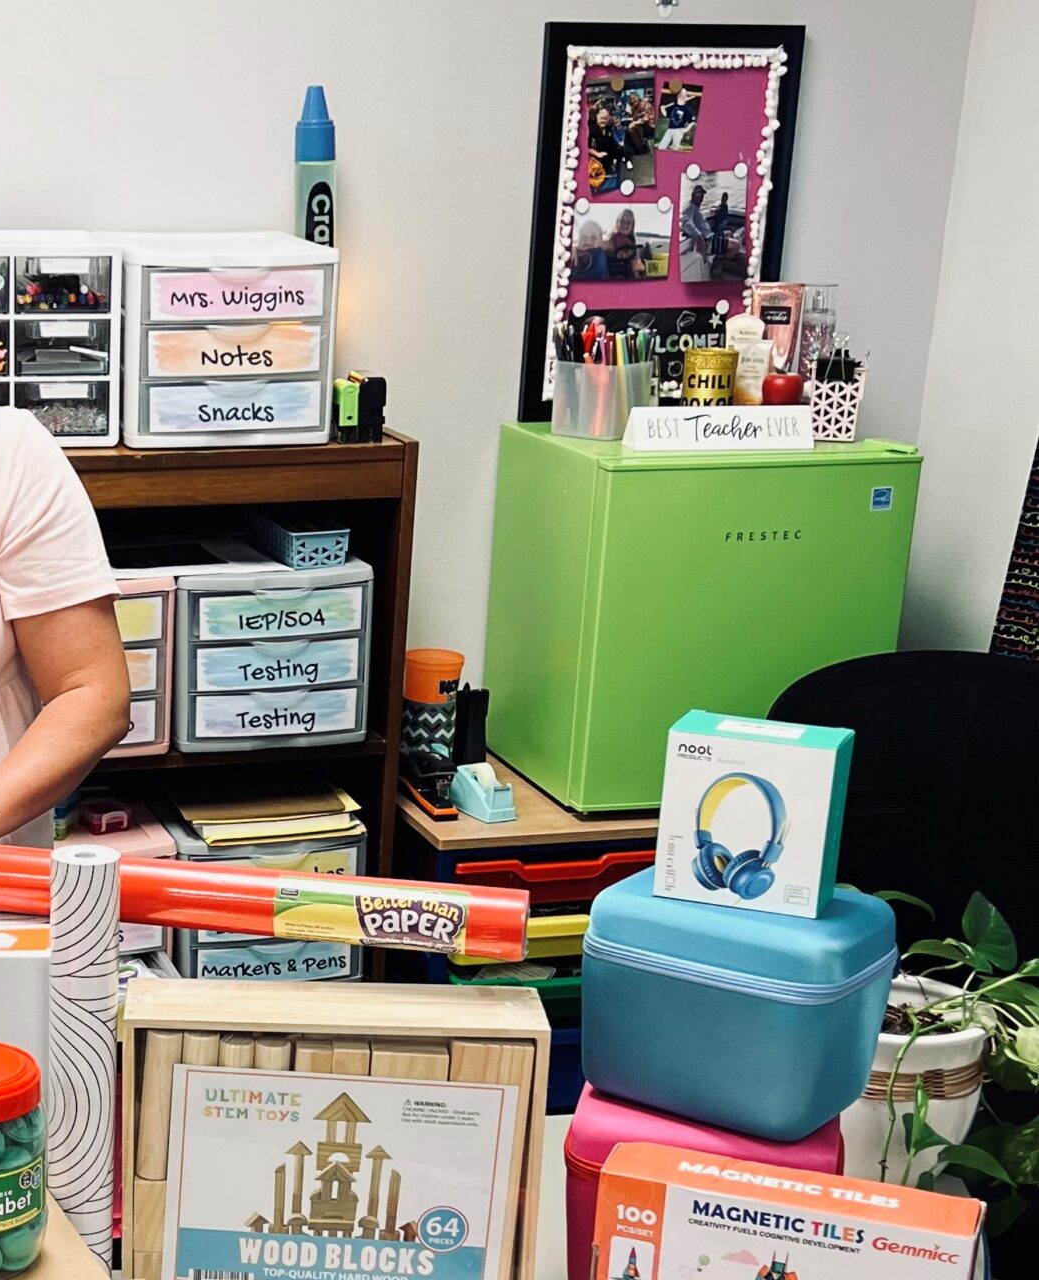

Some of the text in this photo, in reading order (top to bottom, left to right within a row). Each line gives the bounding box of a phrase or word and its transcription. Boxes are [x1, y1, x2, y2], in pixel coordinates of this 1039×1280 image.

[311, 194, 331, 246] Cra
[170, 286, 305, 312] Mrs. Wiggins
[201, 345, 273, 367] Notes
[688, 374, 731, 389] CHILI
[198, 402, 275, 422] Snacks
[647, 414, 800, 442] BEST Teacher EVER
[725, 530, 801, 542] FRESTEC
[238, 659, 319, 683] Testing
[236, 708, 316, 731] Testing
[360, 895, 459, 922] Better than
[201, 954, 347, 978] Markers & Pens
[204, 1088, 301, 1107] ULTIMATE
[203, 1105, 300, 1122] STEM TOYS
[677, 1160, 901, 1209] MAGNETIC TILES
[425, 1216, 460, 1237] 64
[616, 1203, 657, 1227] 100
[691, 1199, 866, 1245] MAGNETIC TILES
[428, 1237, 455, 1246] PIECES
[616, 1223, 655, 1238] PCS/SET
[688, 1217, 861, 1255] CREATIVITY FUELS COGNITIVE DEVELOPMENT
[239, 1237, 436, 1276] WOOD BLOCKS
[872, 1236, 960, 1265] Gemmicc
